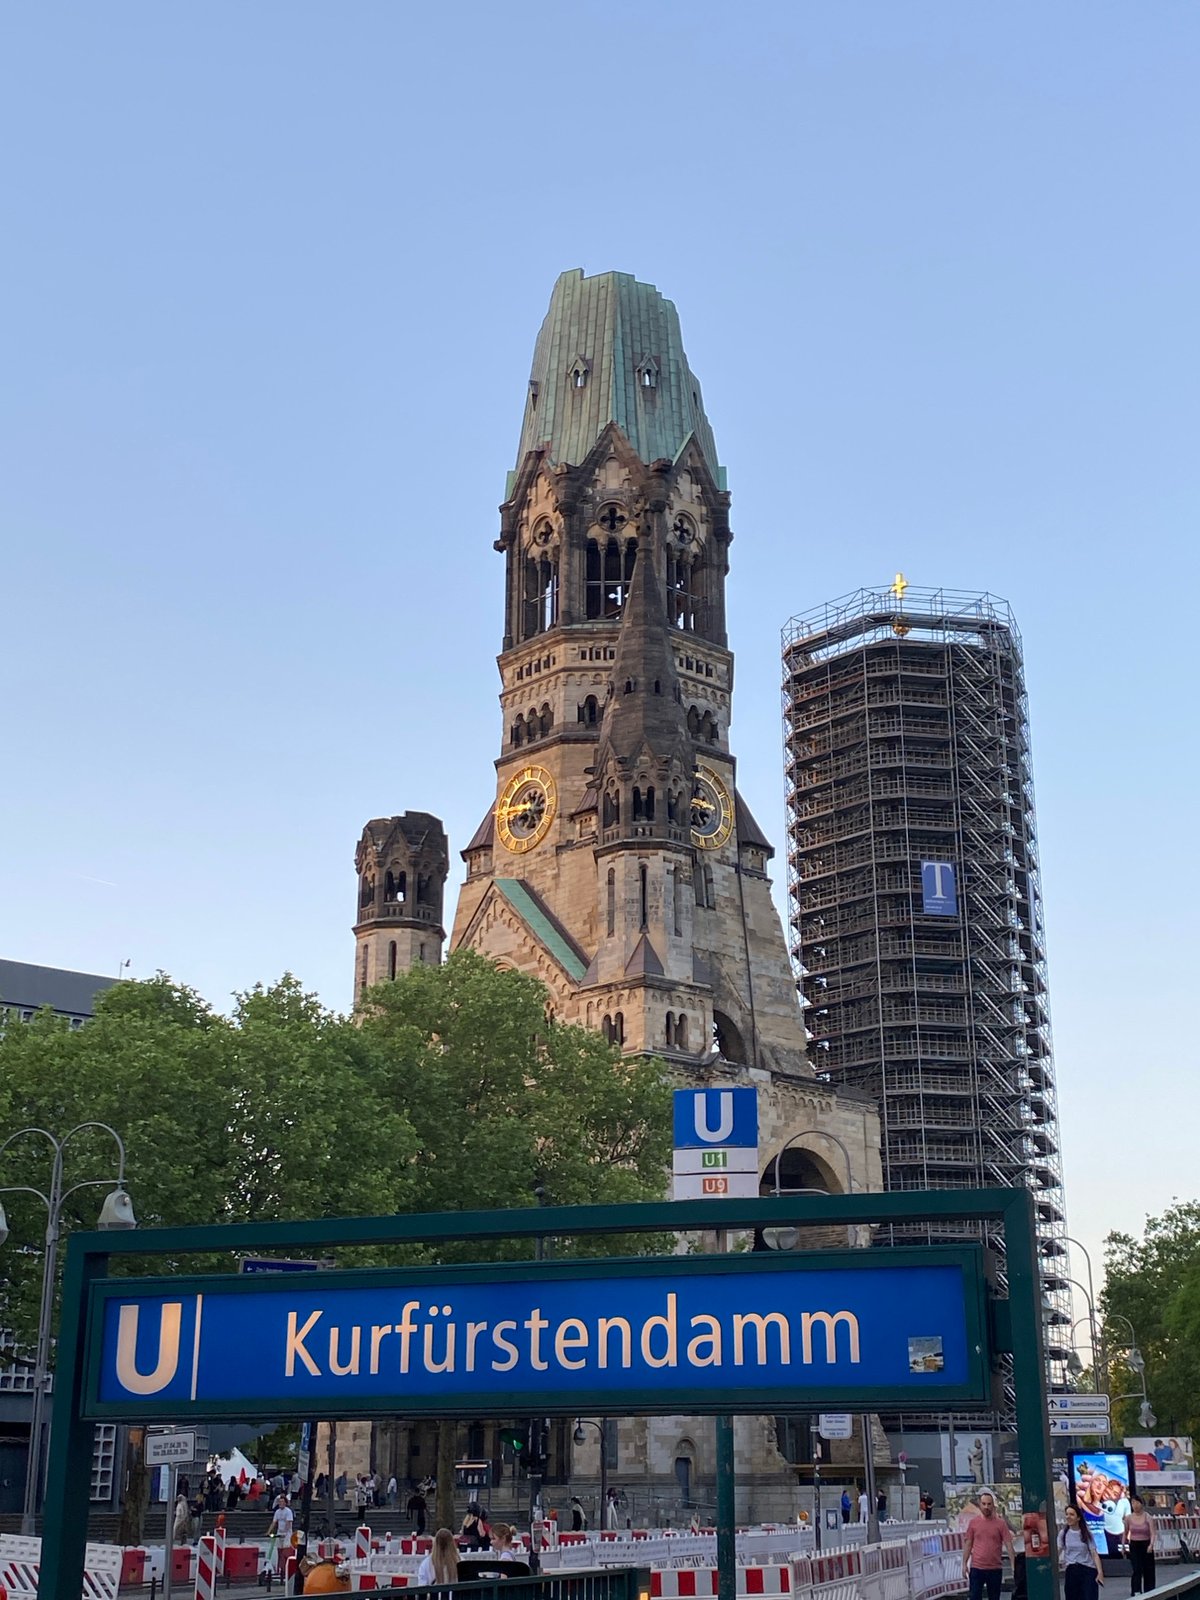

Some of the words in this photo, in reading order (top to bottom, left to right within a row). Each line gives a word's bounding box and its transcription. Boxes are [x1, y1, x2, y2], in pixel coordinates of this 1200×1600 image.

[923, 861, 953, 899] T
[694, 1091, 734, 1143] U
[704, 1152, 724, 1166] U1
[704, 1179, 726, 1193] U9
[115, 1302, 182, 1395] U
[284, 1292, 861, 1378] Kurfürstendamm
